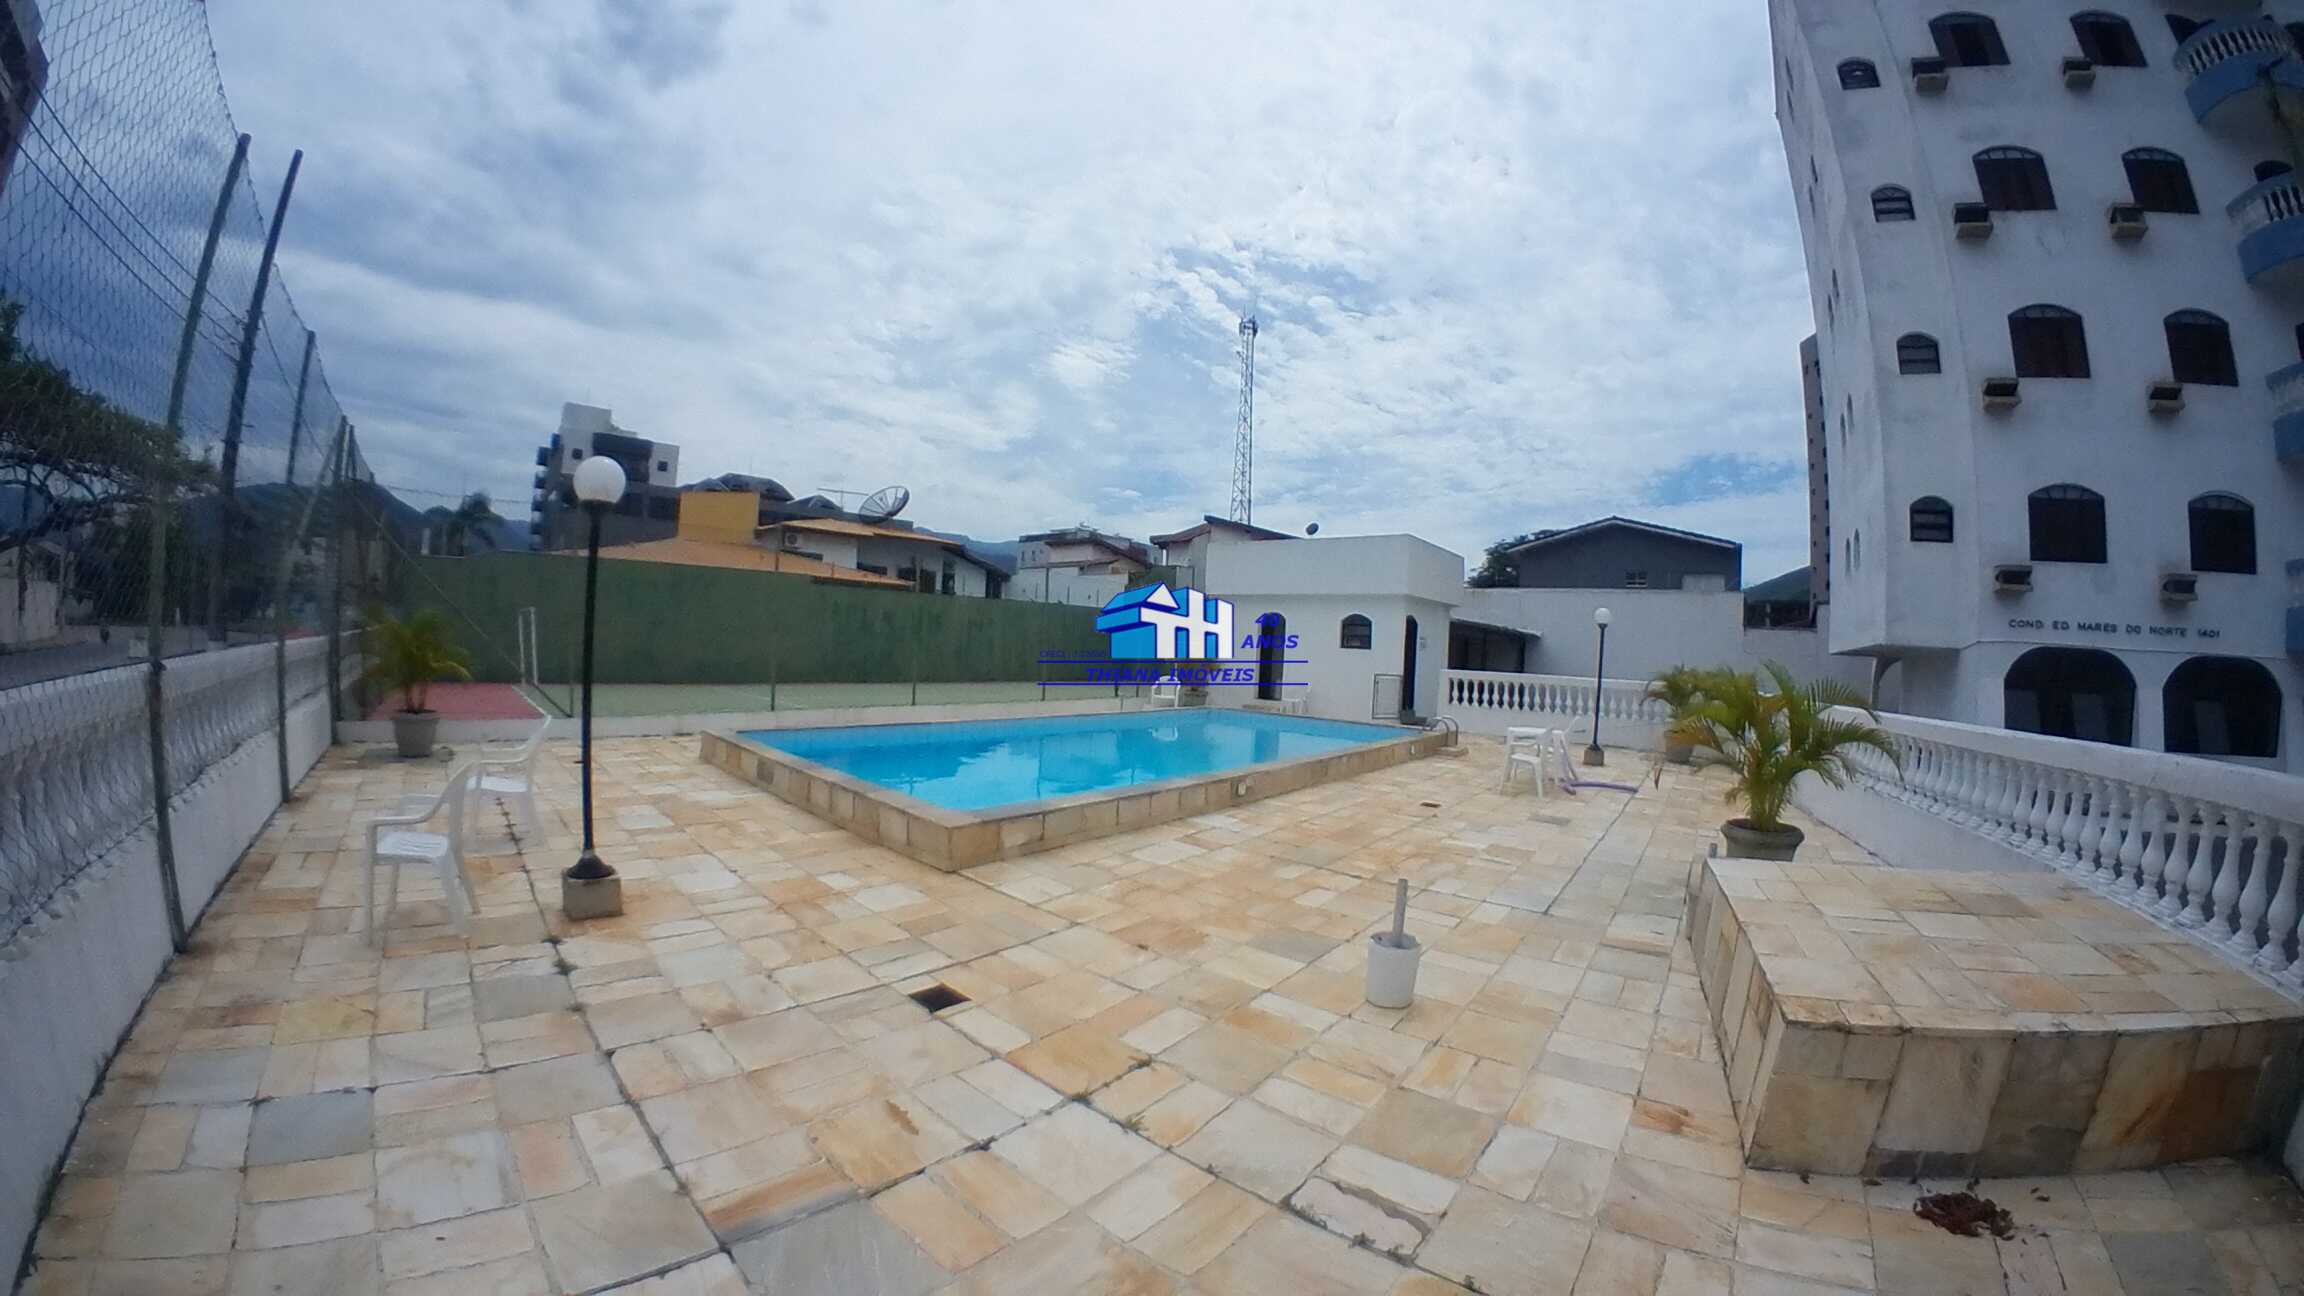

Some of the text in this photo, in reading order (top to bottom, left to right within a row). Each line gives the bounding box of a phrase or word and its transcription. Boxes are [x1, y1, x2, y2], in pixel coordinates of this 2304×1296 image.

[2077, 621, 2117, 634] MARES
[2126, 623, 2142, 635] DO
[2149, 624, 2188, 637] NORTE
